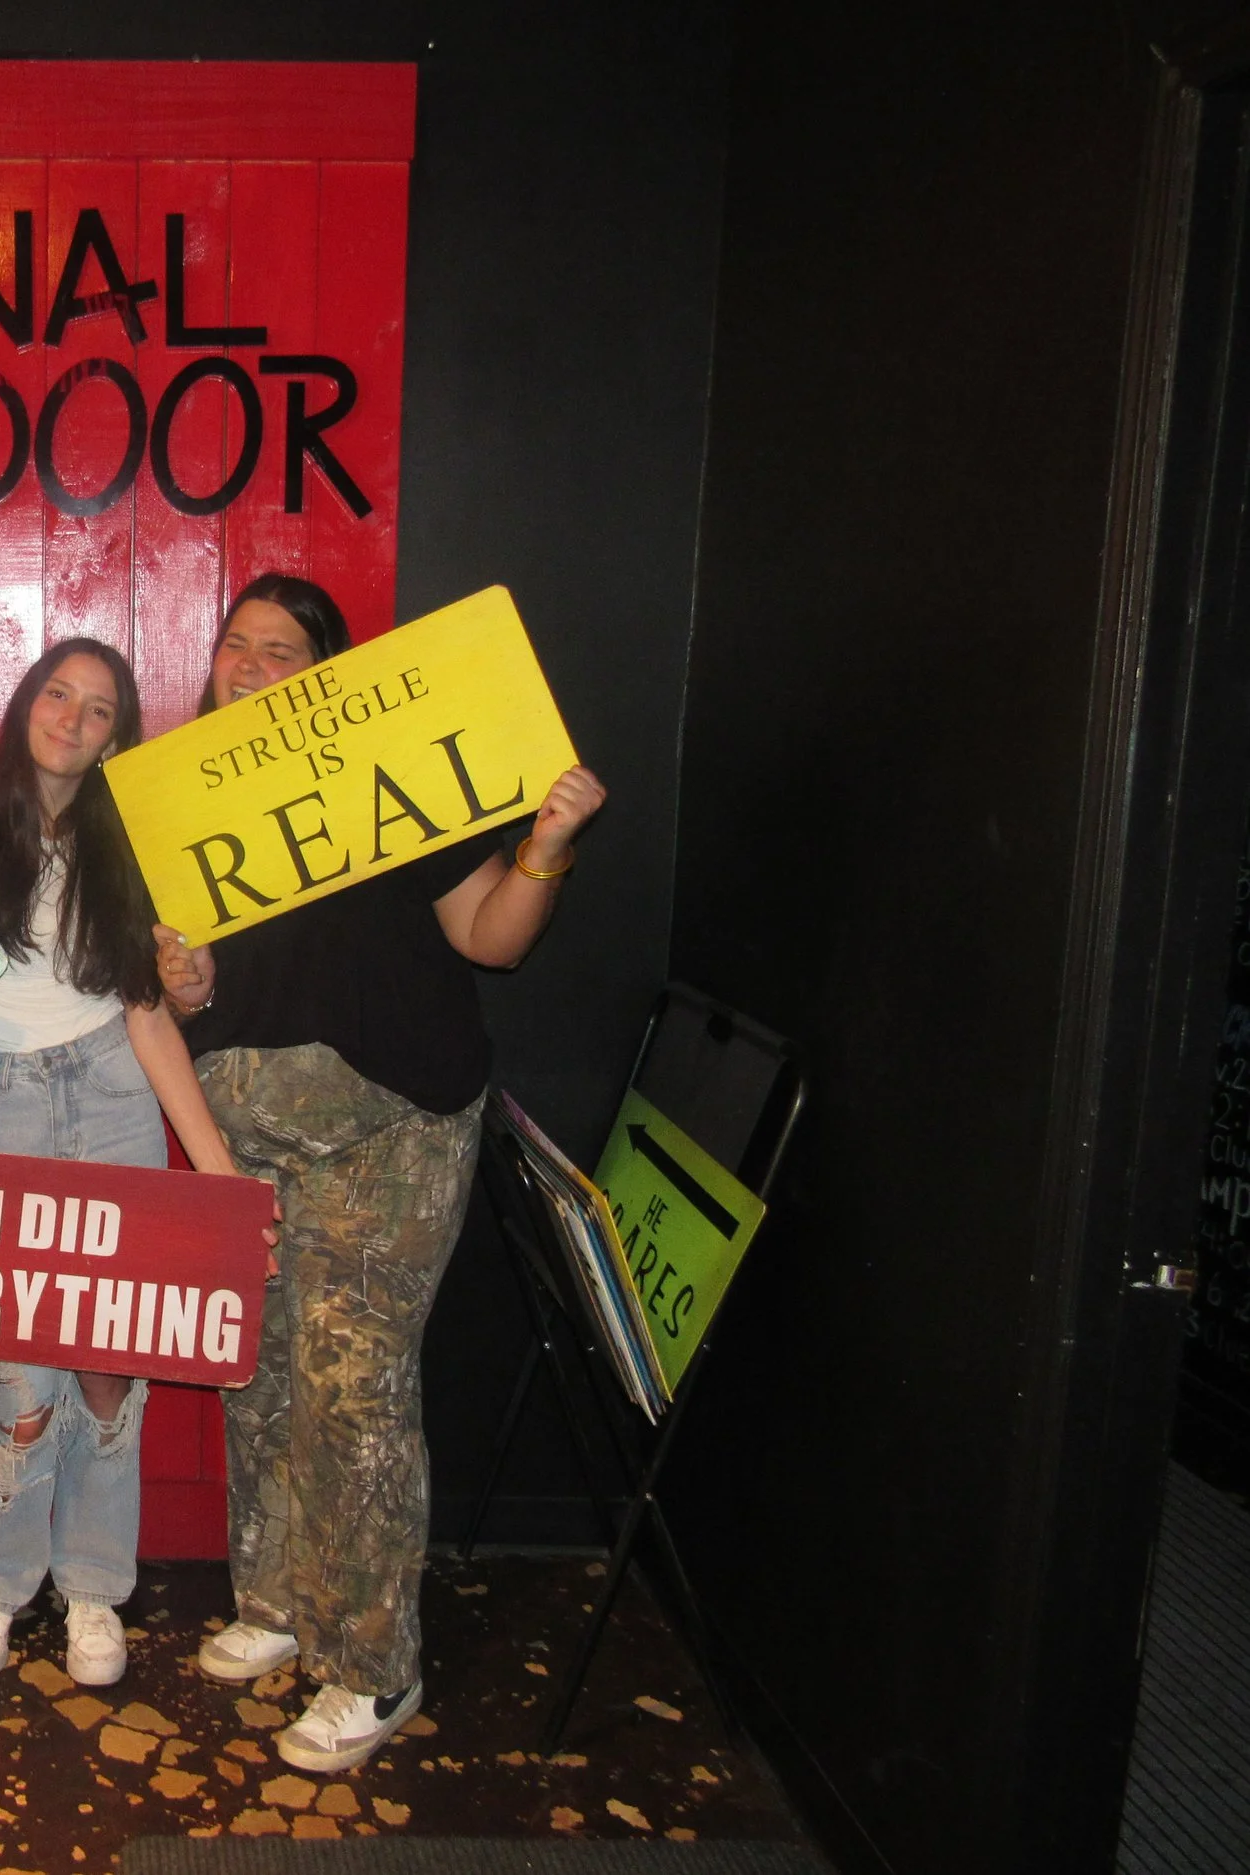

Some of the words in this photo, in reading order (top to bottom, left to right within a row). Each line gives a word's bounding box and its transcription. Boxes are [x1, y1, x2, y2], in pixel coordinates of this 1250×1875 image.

[255, 666, 344, 726] THE
[198, 667, 430, 790] STRUGGLE
[304, 742, 345, 783] IS
[181, 728, 525, 930] REAL
[18, 1192, 122, 1257] DID
[642, 1194, 669, 1236] HE
